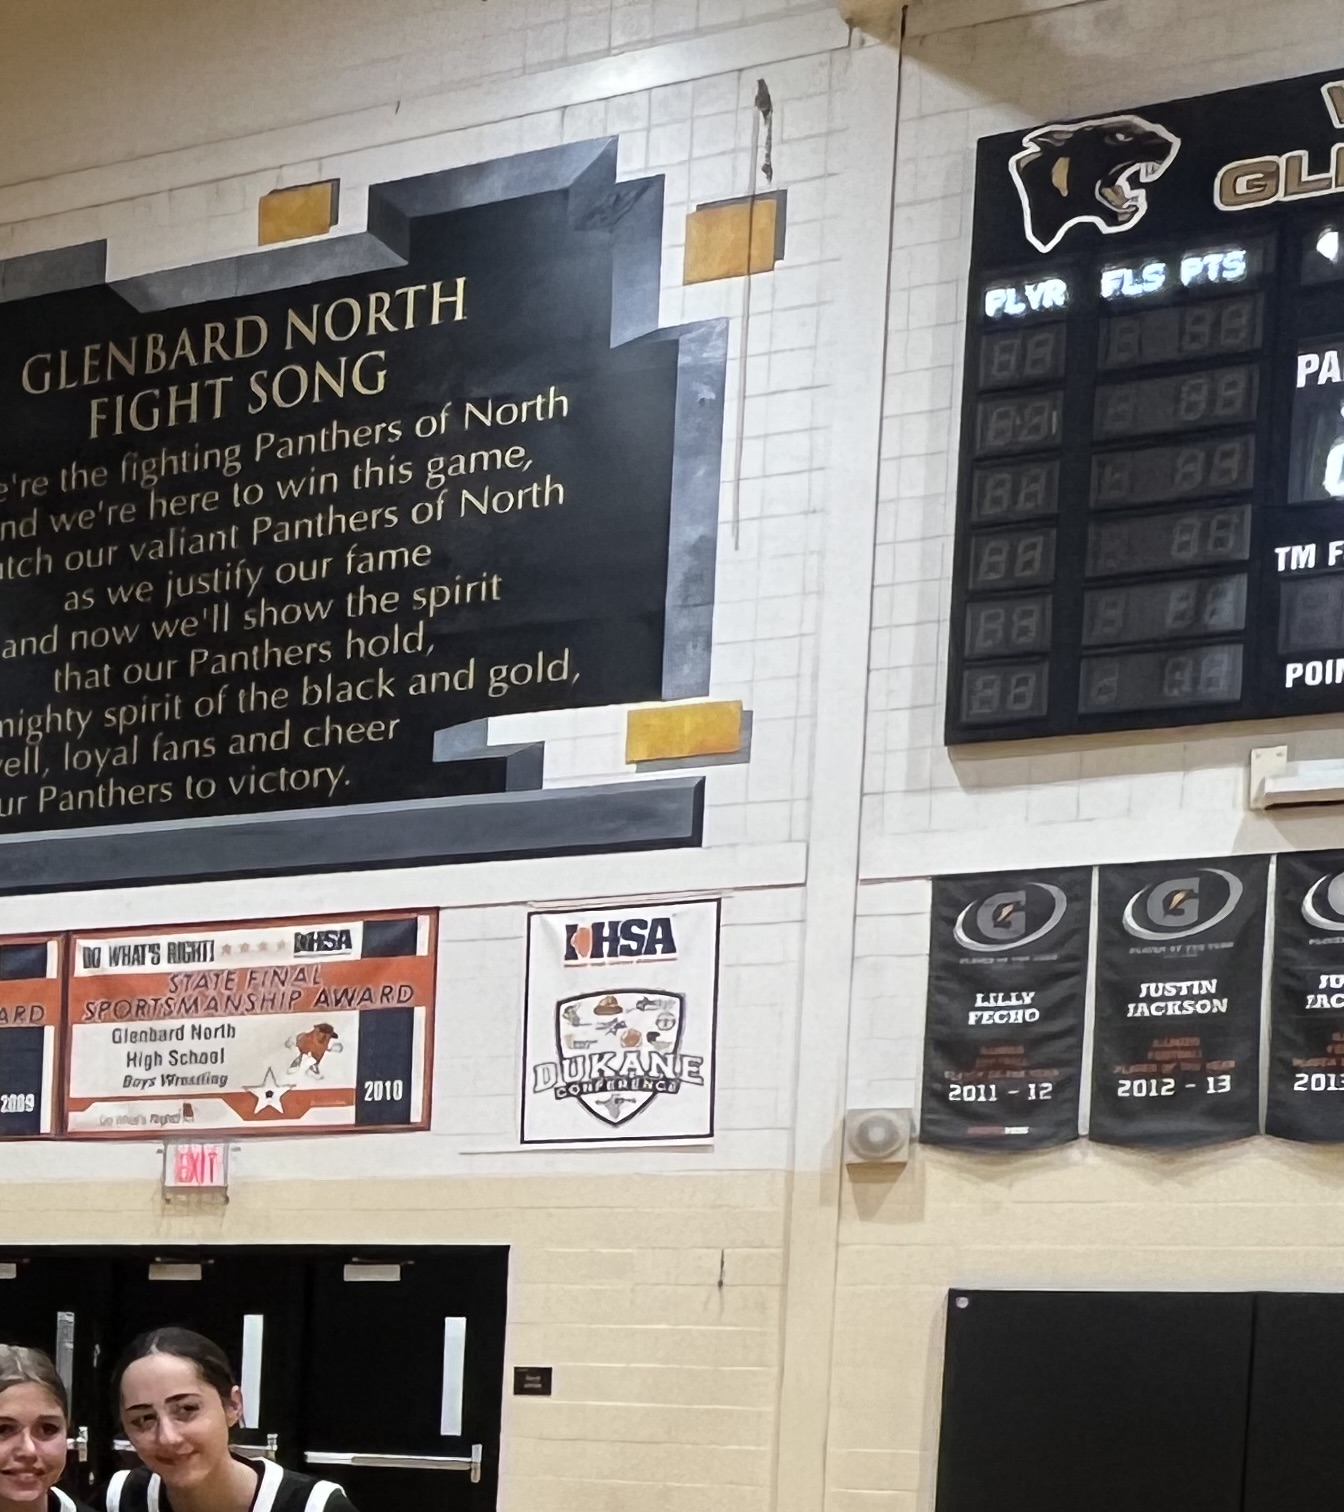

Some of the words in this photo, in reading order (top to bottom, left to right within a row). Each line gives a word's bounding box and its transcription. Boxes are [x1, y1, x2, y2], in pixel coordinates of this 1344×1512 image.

[984, 278, 1069, 318] PLYR
[1100, 262, 1166, 300] FLS
[1180, 250, 1247, 287] PTS
[22, 316, 267, 394] GLENBARD
[285, 277, 467, 350] NORTH
[90, 376, 233, 439] FIGHT
[248, 351, 387, 414] SONG
[61, 461, 107, 492] the
[122, 444, 241, 488] fighting
[255, 420, 402, 462] Panthers
[415, 401, 452, 437] of
[465, 386, 568, 430] North
[50, 501, 136, 532] we're
[150, 488, 219, 520] here
[233, 483, 263, 507] to
[277, 467, 337, 499] win
[354, 455, 412, 489] this
[426, 446, 532, 490] game,
[65, 546, 118, 570] our
[130, 525, 238, 561] valiant
[253, 504, 398, 545] Panthers
[412, 489, 448, 524] of
[460, 474, 564, 517] North
[65, 589, 94, 611] as
[107, 582, 153, 605] we
[166, 559, 263, 607] justify
[276, 558, 333, 584] our
[347, 544, 431, 574] fame
[1274, 543, 1316, 572] TM
[2, 624, 58, 659] and
[72, 624, 139, 650] now
[152, 602, 229, 640] we'll
[244, 598, 333, 629] show
[347, 585, 399, 617] the
[413, 572, 502, 617] spirit
[55, 662, 110, 692] that
[124, 660, 178, 683] our
[190, 638, 331, 677] Panthers
[347, 620, 434, 659] hold,
[105, 693, 181, 735] spirit
[195, 684, 228, 717] of
[239, 682, 288, 713] the
[302, 668, 394, 705] black
[409, 658, 475, 695] and
[489, 648, 579, 697] gold,
[65, 735, 138, 777] loyal
[153, 732, 215, 761] fans
[229, 719, 290, 754] and
[304, 715, 400, 747] cheer
[39, 778, 172, 812] Panthers
[186, 776, 216, 799] to
[229, 766, 349, 796] victory.
[168, 968, 237, 995] STATE
[247, 964, 323, 990] FINAL
[974, 991, 1036, 1008] LILLY
[1139, 978, 1218, 998] JUSTIN
[84, 990, 303, 1022] SPORTSMANSHIP
[313, 984, 414, 1008] AWARD
[1126, 998, 1229, 1018] JACKSON
[112, 1025, 184, 1045] Glenbard
[191, 1023, 236, 1041] North
[126, 1053, 163, 1073] High
[168, 1048, 225, 1067] School
[532, 1049, 704, 1094] DUKANE
[0, 1093, 35, 1114] 2009
[364, 1079, 403, 1102] 2010
[948, 1084, 998, 1102] 2011
[1027, 1082, 1053, 1101] 12
[1117, 1078, 1175, 1097] 2012
[1206, 1075, 1231, 1094] 13
[176, 1148, 220, 1184] EXIT
